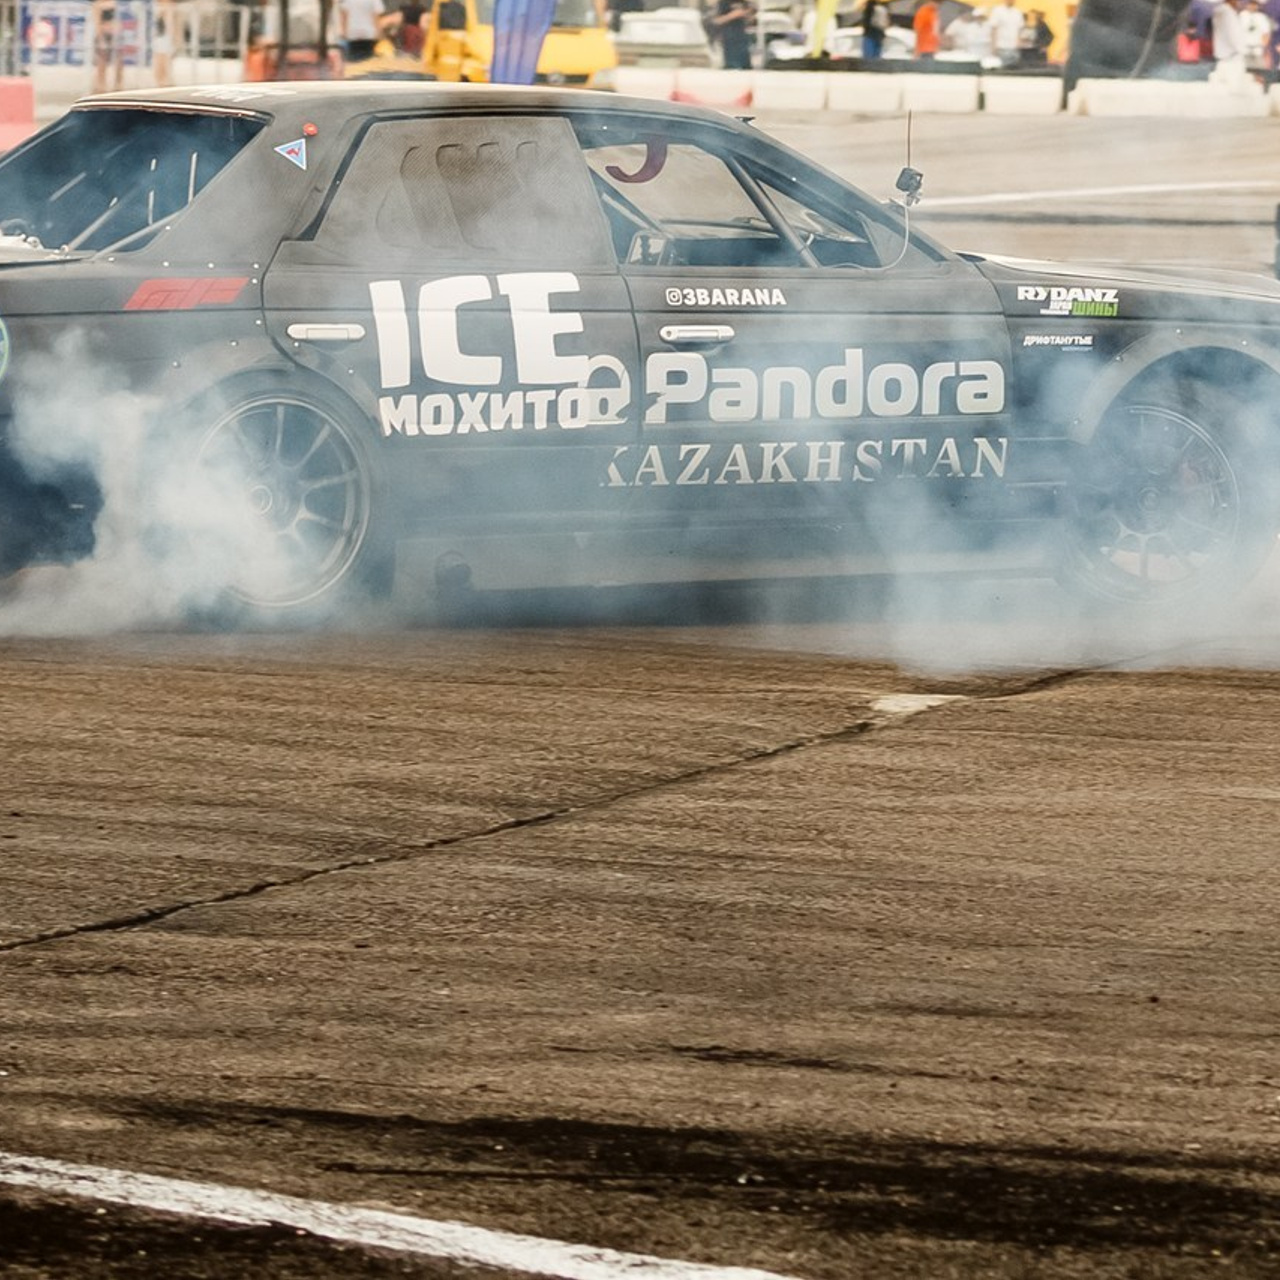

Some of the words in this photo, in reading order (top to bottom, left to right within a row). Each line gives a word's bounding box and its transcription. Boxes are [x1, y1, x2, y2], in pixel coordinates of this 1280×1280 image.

[369, 272, 590, 388] ICE
[1017, 286, 1119, 303] RYDANZ
[645, 348, 1005, 424] Pandora
